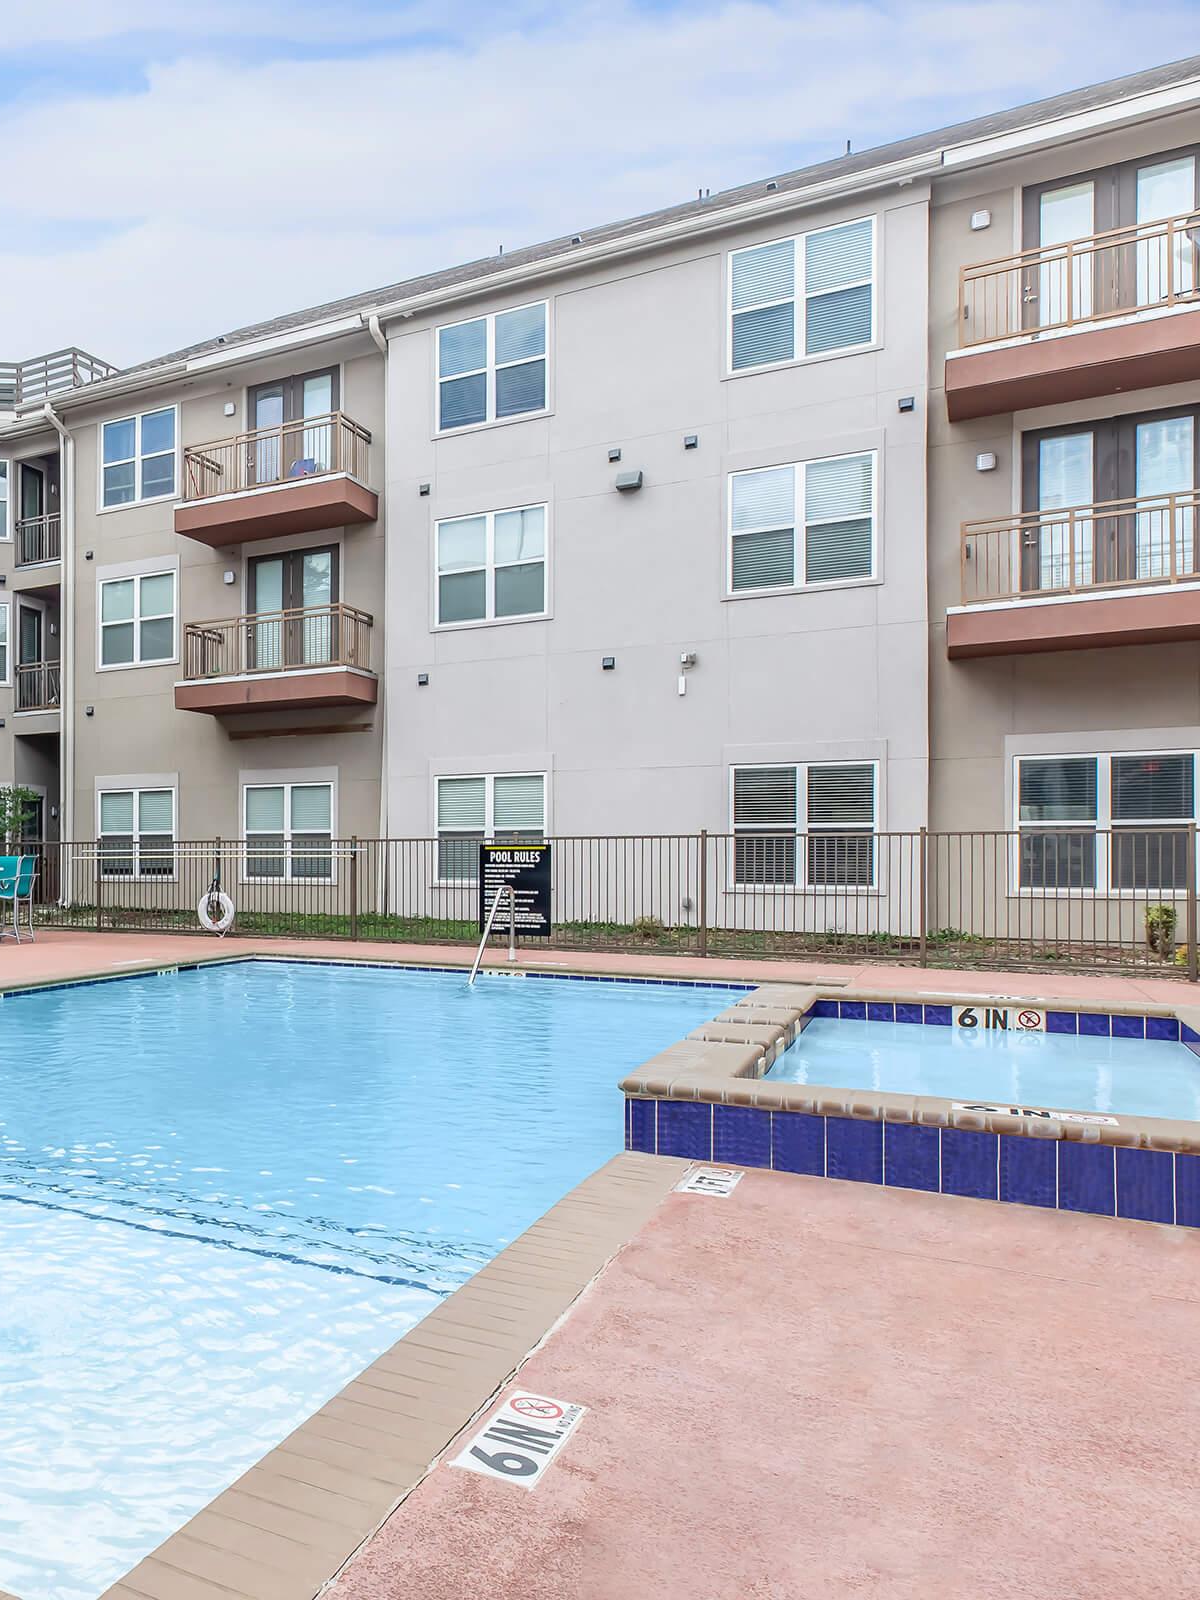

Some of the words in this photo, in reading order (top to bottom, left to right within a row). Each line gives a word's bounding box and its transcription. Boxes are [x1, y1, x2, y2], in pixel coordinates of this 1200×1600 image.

[489, 850, 512, 863] POOL
[513, 850, 540, 863] RULES
[958, 1007, 978, 1028] 6
[482, 1418, 565, 1455] IN.
[469, 1445, 539, 1477] 6
